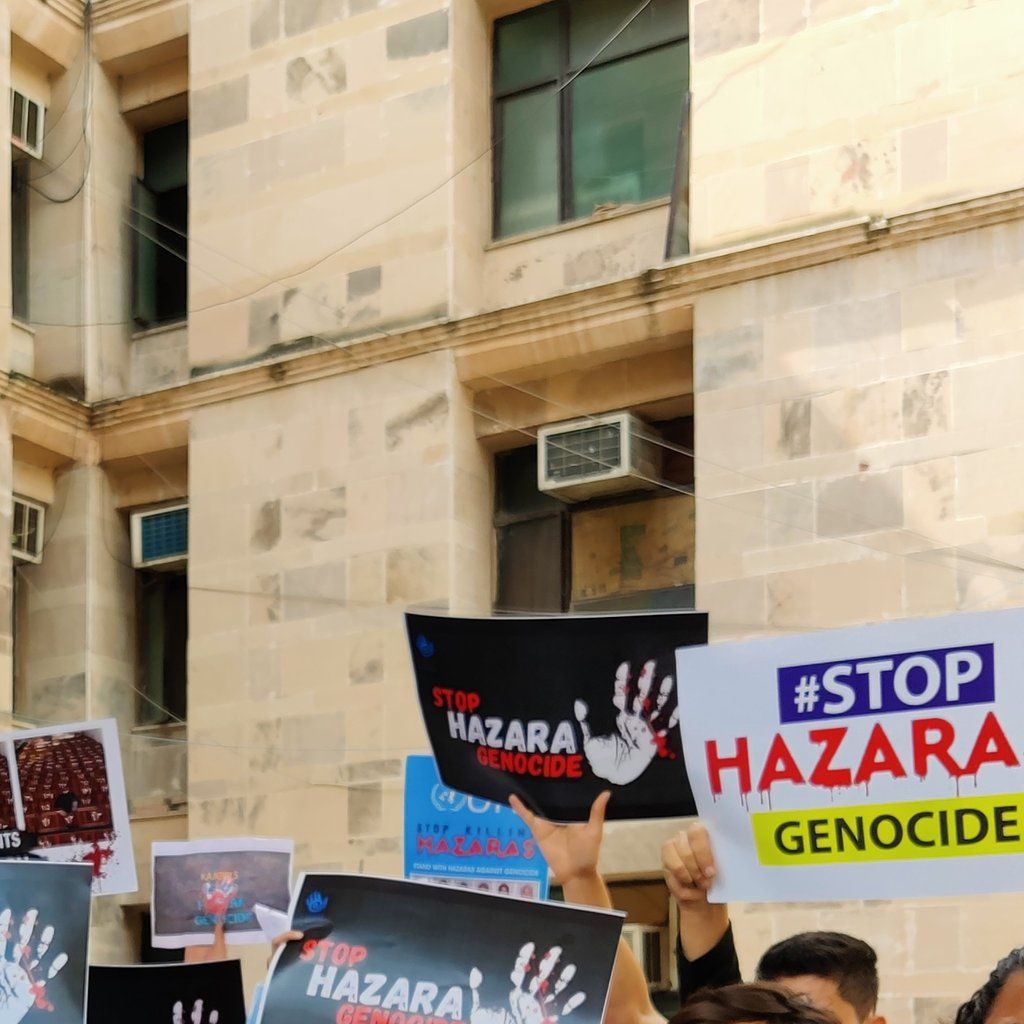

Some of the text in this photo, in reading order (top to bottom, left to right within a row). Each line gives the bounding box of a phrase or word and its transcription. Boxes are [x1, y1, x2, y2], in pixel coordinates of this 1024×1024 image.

[432, 687, 481, 713] STOP
[794, 649, 983, 717] #STOP
[448, 709, 577, 755] HAZARA
[476, 745, 583, 779] GENOCIDE
[706, 711, 1020, 794] HAZARA
[416, 822, 526, 837] STOP KILLIN
[416, 836, 536, 860] HAZARAS
[774, 805, 1020, 855] GENOCIDE
[301, 939, 367, 968] STOP
[306, 964, 463, 1021] HAZARA
